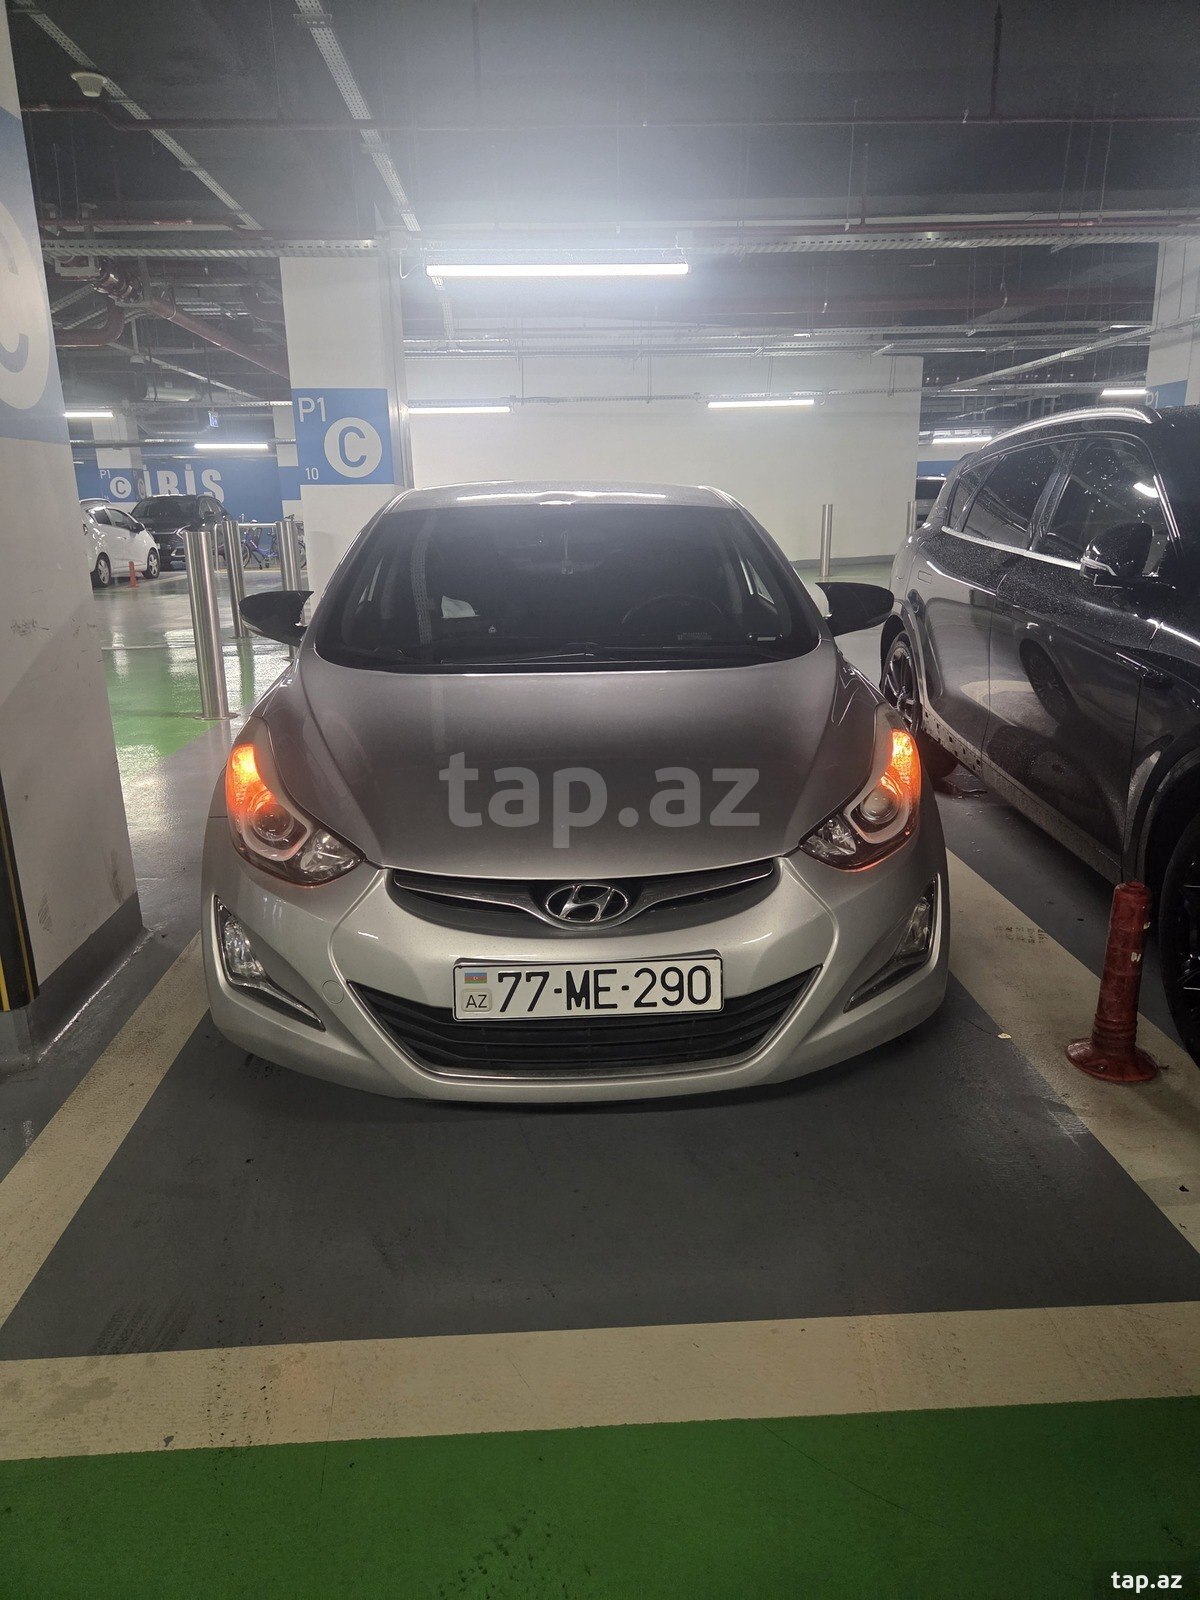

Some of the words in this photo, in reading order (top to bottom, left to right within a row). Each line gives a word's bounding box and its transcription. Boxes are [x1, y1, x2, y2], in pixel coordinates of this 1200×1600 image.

[298, 397, 326, 422] P1
[338, 426, 367, 468] C
[99, 469, 111, 479] P1
[305, 467, 319, 480] 10
[115, 479, 127, 495] C
[497, 964, 712, 1012] 77-ME-290
[465, 994, 488, 1008] AZ
